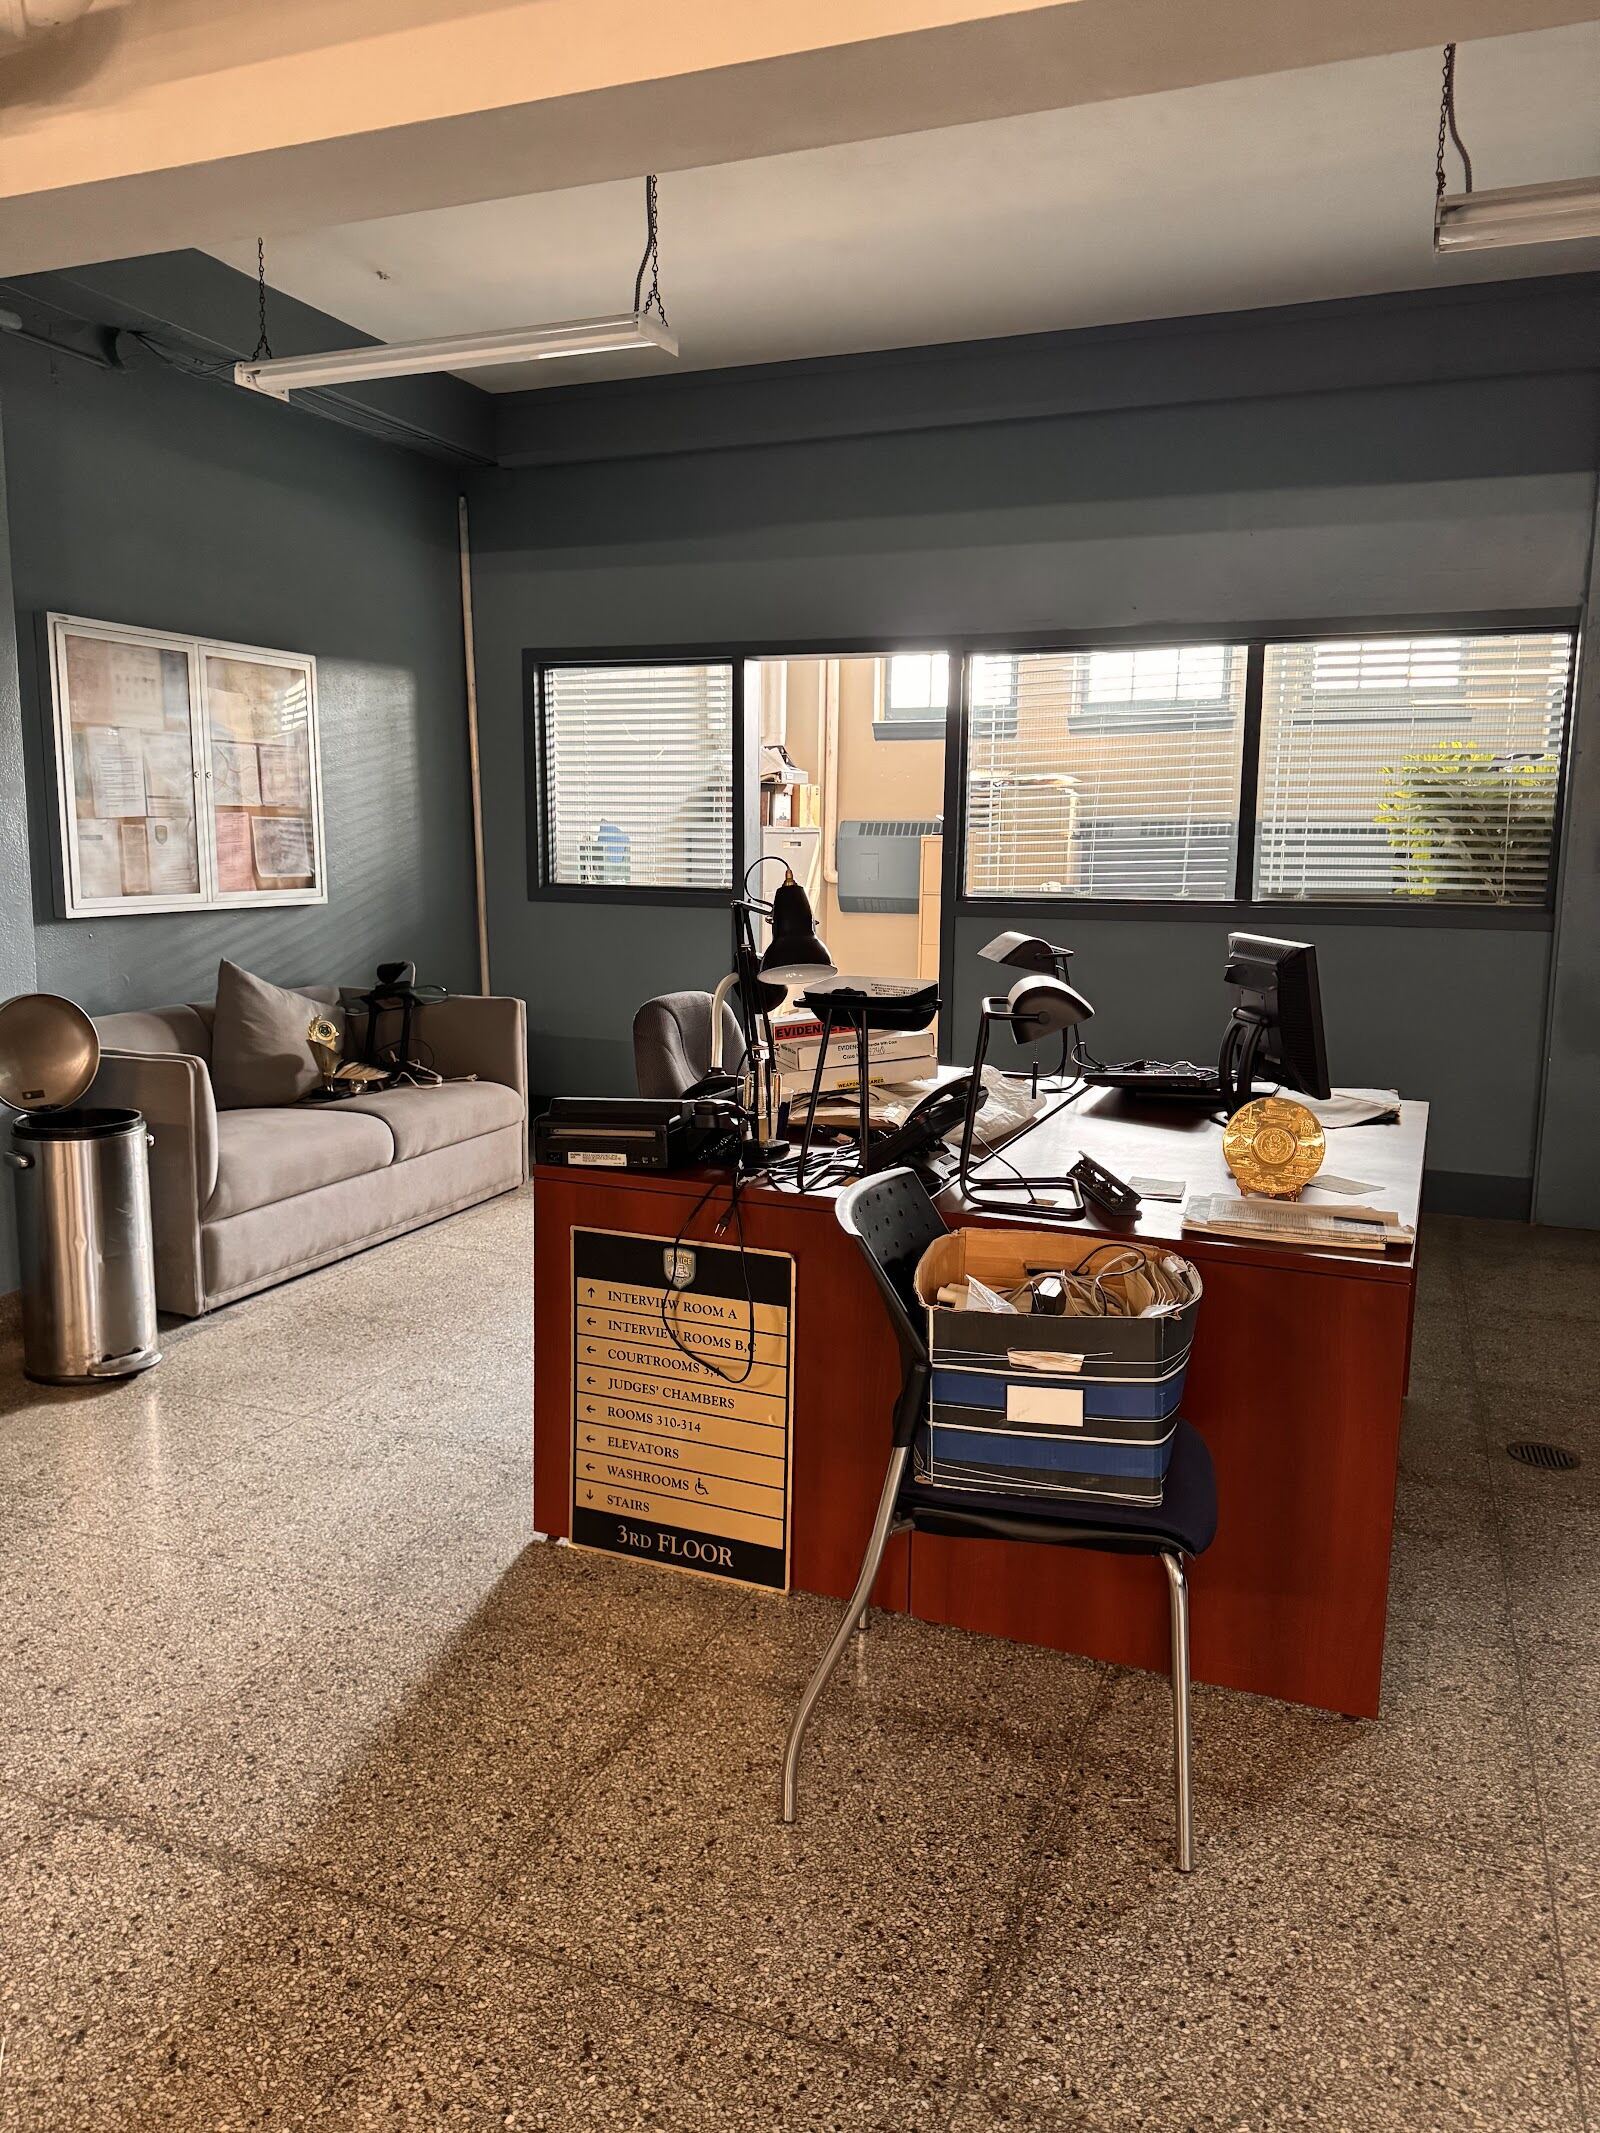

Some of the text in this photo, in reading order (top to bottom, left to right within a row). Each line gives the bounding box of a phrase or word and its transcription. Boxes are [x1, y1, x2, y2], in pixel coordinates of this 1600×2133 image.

[777, 1023, 835, 1038] EVIDEN
[607, 1290, 738, 1319] INTERVIEW ROOM A
[607, 1319, 680, 1340] INTERVIEW
[683, 1331, 731, 1349] ROOMS
[607, 1348, 700, 1374] COURTROOMS
[607, 1377, 736, 1409] JUDGES' CHAMBERS
[607, 1406, 701, 1433] ROOMS 310-314
[607, 1436, 680, 1459] ELEVATORS
[607, 1464, 690, 1490] WASHROOMS
[606, 1494, 650, 1512] STAIRS
[657, 1532, 734, 1567] FLOOR
